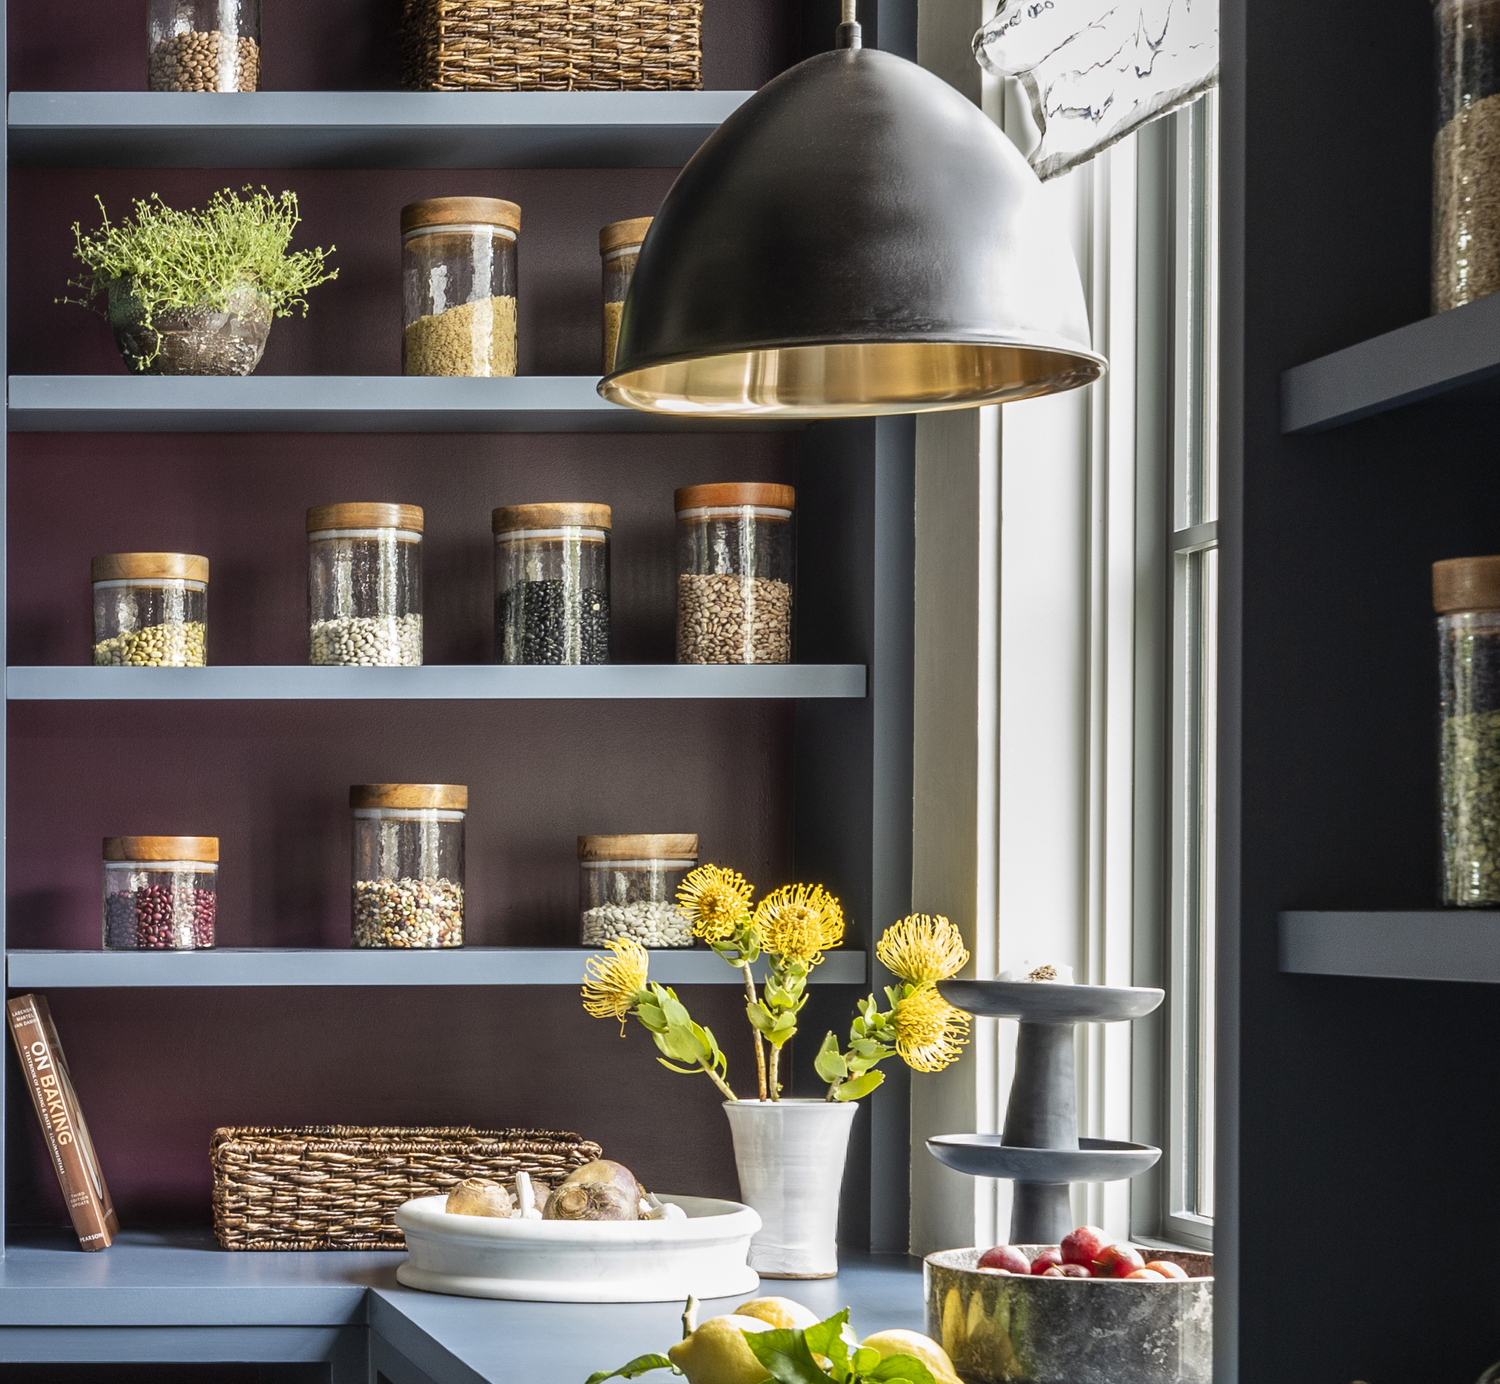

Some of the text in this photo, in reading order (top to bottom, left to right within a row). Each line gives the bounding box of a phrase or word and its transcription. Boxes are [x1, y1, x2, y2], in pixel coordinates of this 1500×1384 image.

[31, 1041, 73, 1146] ON BAKING
[79, 1232, 105, 1243] PEARSON
